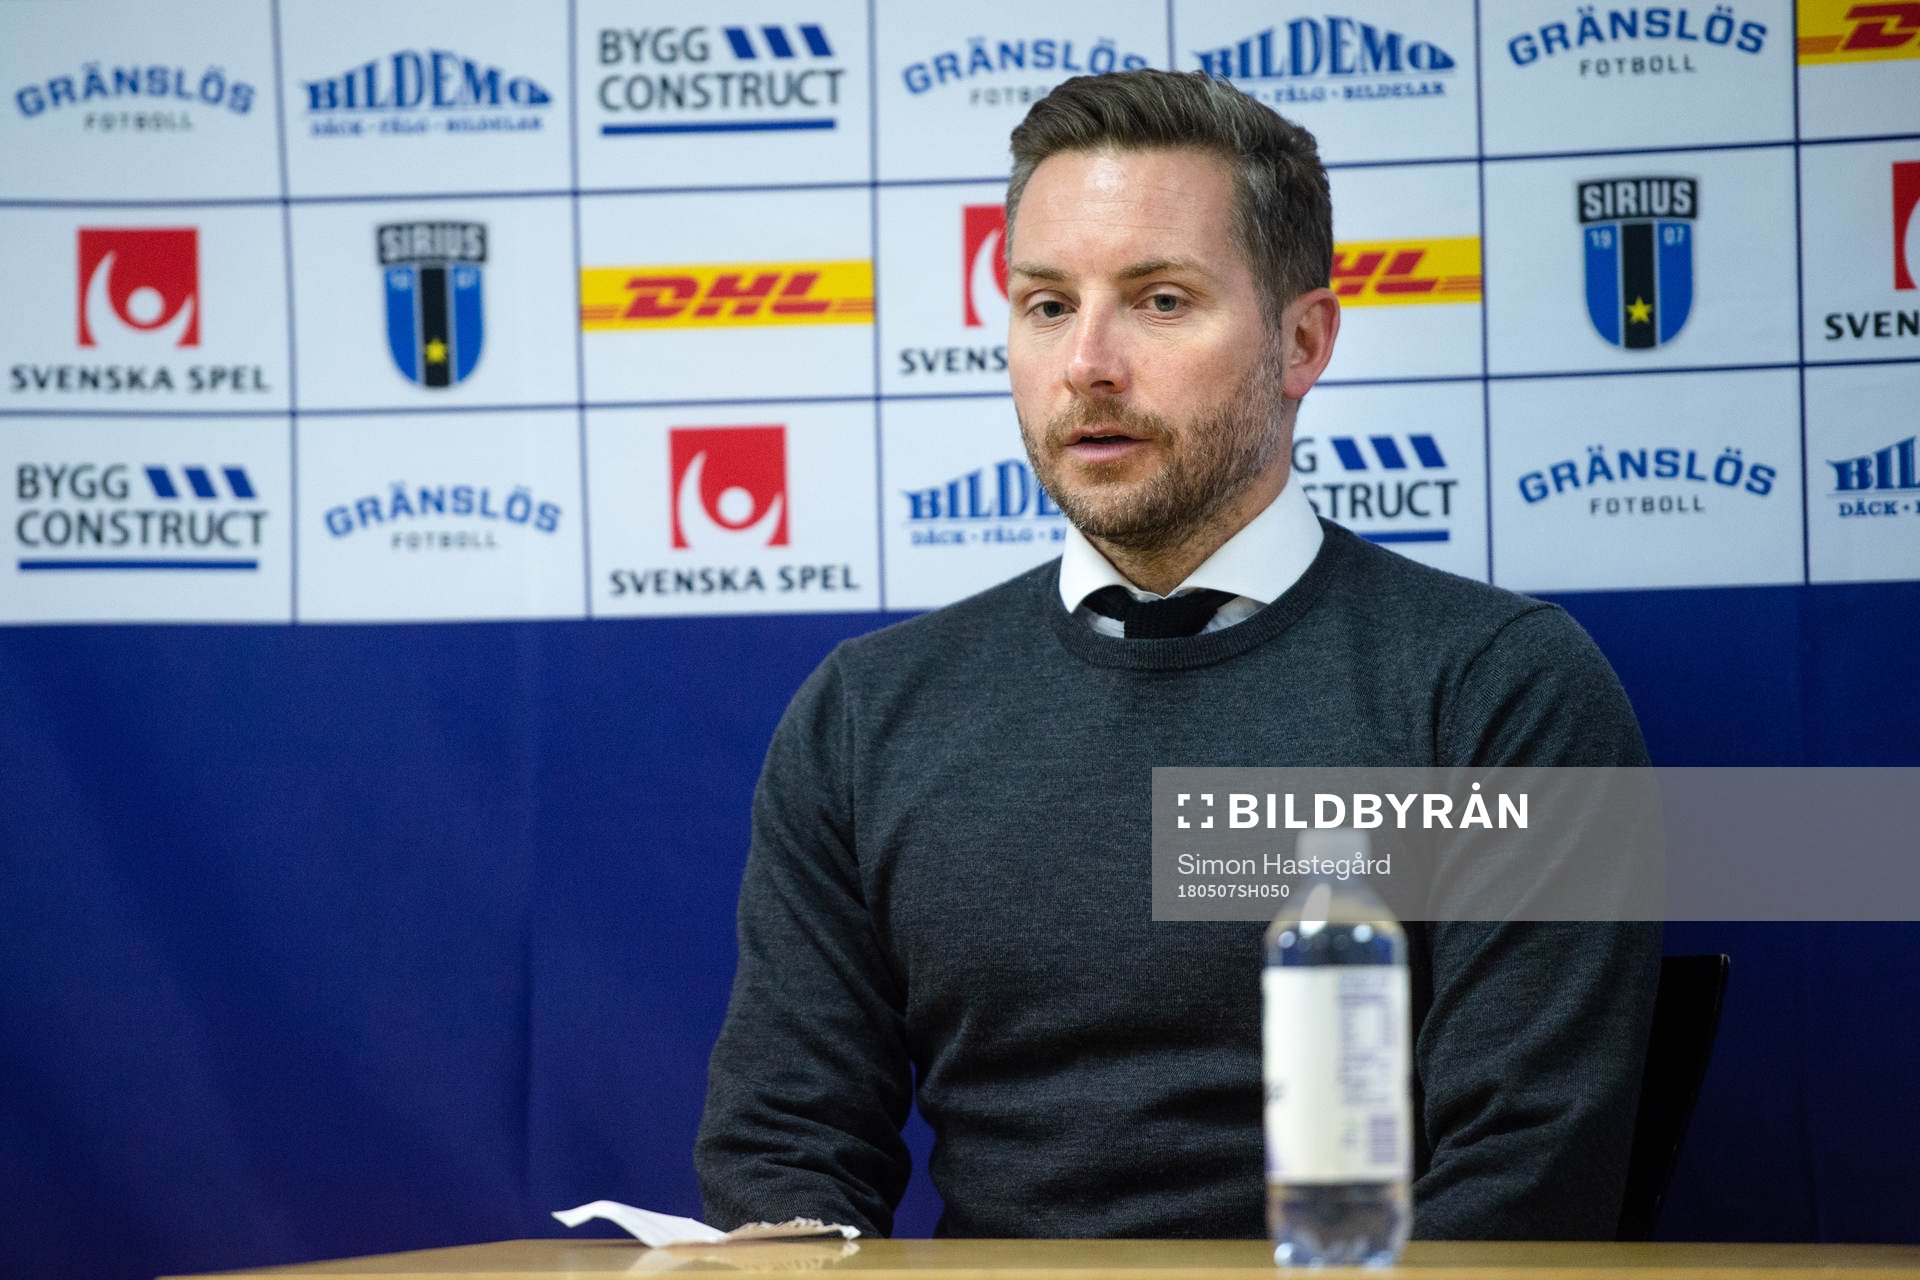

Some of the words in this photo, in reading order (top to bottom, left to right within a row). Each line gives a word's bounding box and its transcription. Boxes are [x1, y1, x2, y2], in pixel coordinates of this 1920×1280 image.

[598, 26, 710, 65] BYGG
[1508, 5, 1768, 67] GRÄNSLÖS
[1579, 53, 1696, 77] FOTBOLL
[14, 61, 256, 118] GRÄNSLÖS
[598, 69, 846, 112] CONSTRUCT
[969, 86, 1050, 106] FOTBO
[83, 112, 194, 133] FOTBOLL
[1583, 180, 1692, 219] SIRIUS
[1591, 229, 1613, 249] 19
[1662, 226, 1685, 246] 07
[1331, 250, 1438, 296] HL
[624, 271, 833, 319] DHL
[1825, 309, 1920, 341] SVEN
[899, 345, 1008, 374] SVENS
[10, 365, 174, 393] SVENSKA
[187, 365, 269, 393] SPEL
[17, 464, 129, 502] BYGG
[1518, 445, 1777, 504] GRÄNSLÖS
[323, 482, 562, 540] GRÄNSLÖS
[1590, 496, 1705, 516] FOTBOLL
[1838, 499, 1898, 518] DÄCK
[16, 509, 268, 548] CONSTRUCT
[391, 531, 497, 551] FOTBOLL
[610, 568, 765, 597] SVENSKA
[777, 564, 860, 592] SPEL
